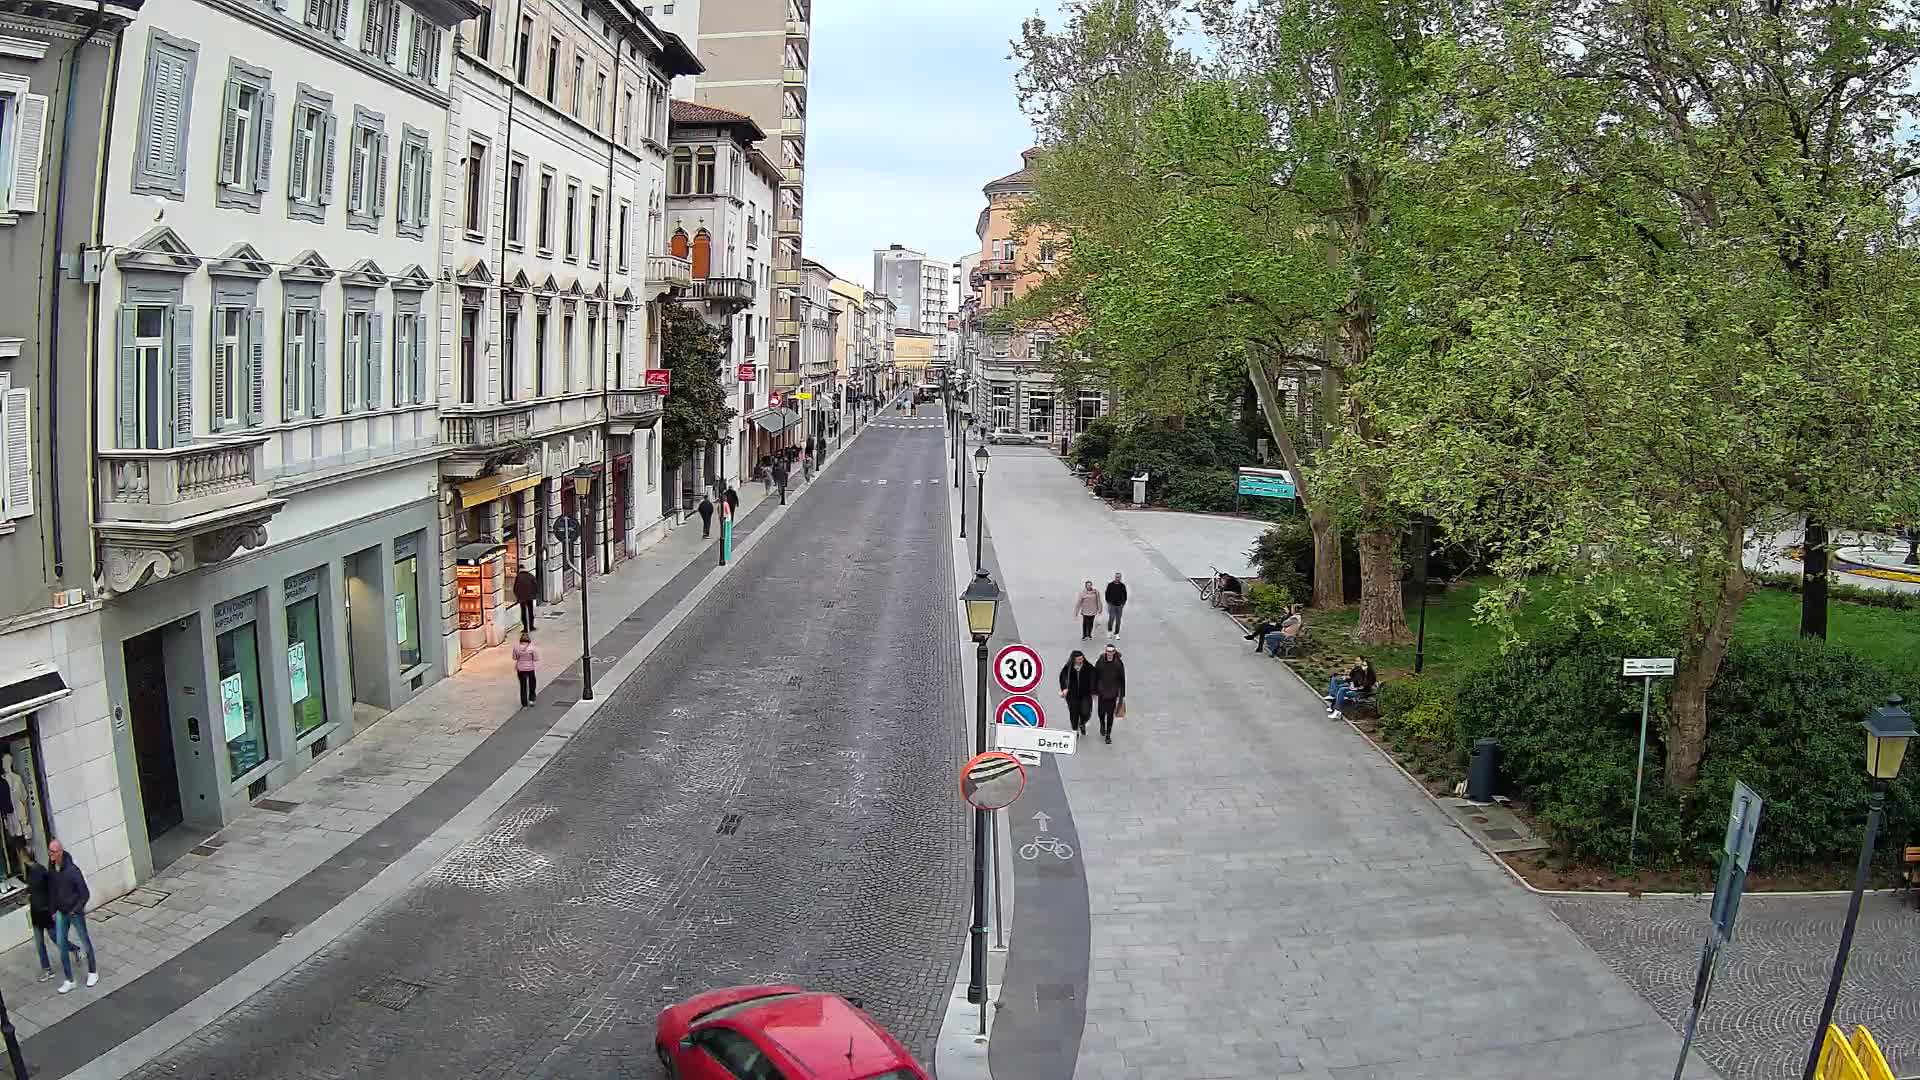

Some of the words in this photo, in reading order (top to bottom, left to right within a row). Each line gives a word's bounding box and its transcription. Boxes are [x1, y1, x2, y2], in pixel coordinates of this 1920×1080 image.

[1005, 658, 1033, 680] 30
[221, 677, 240, 700] 130
[1038, 738, 1069, 749] Dante
